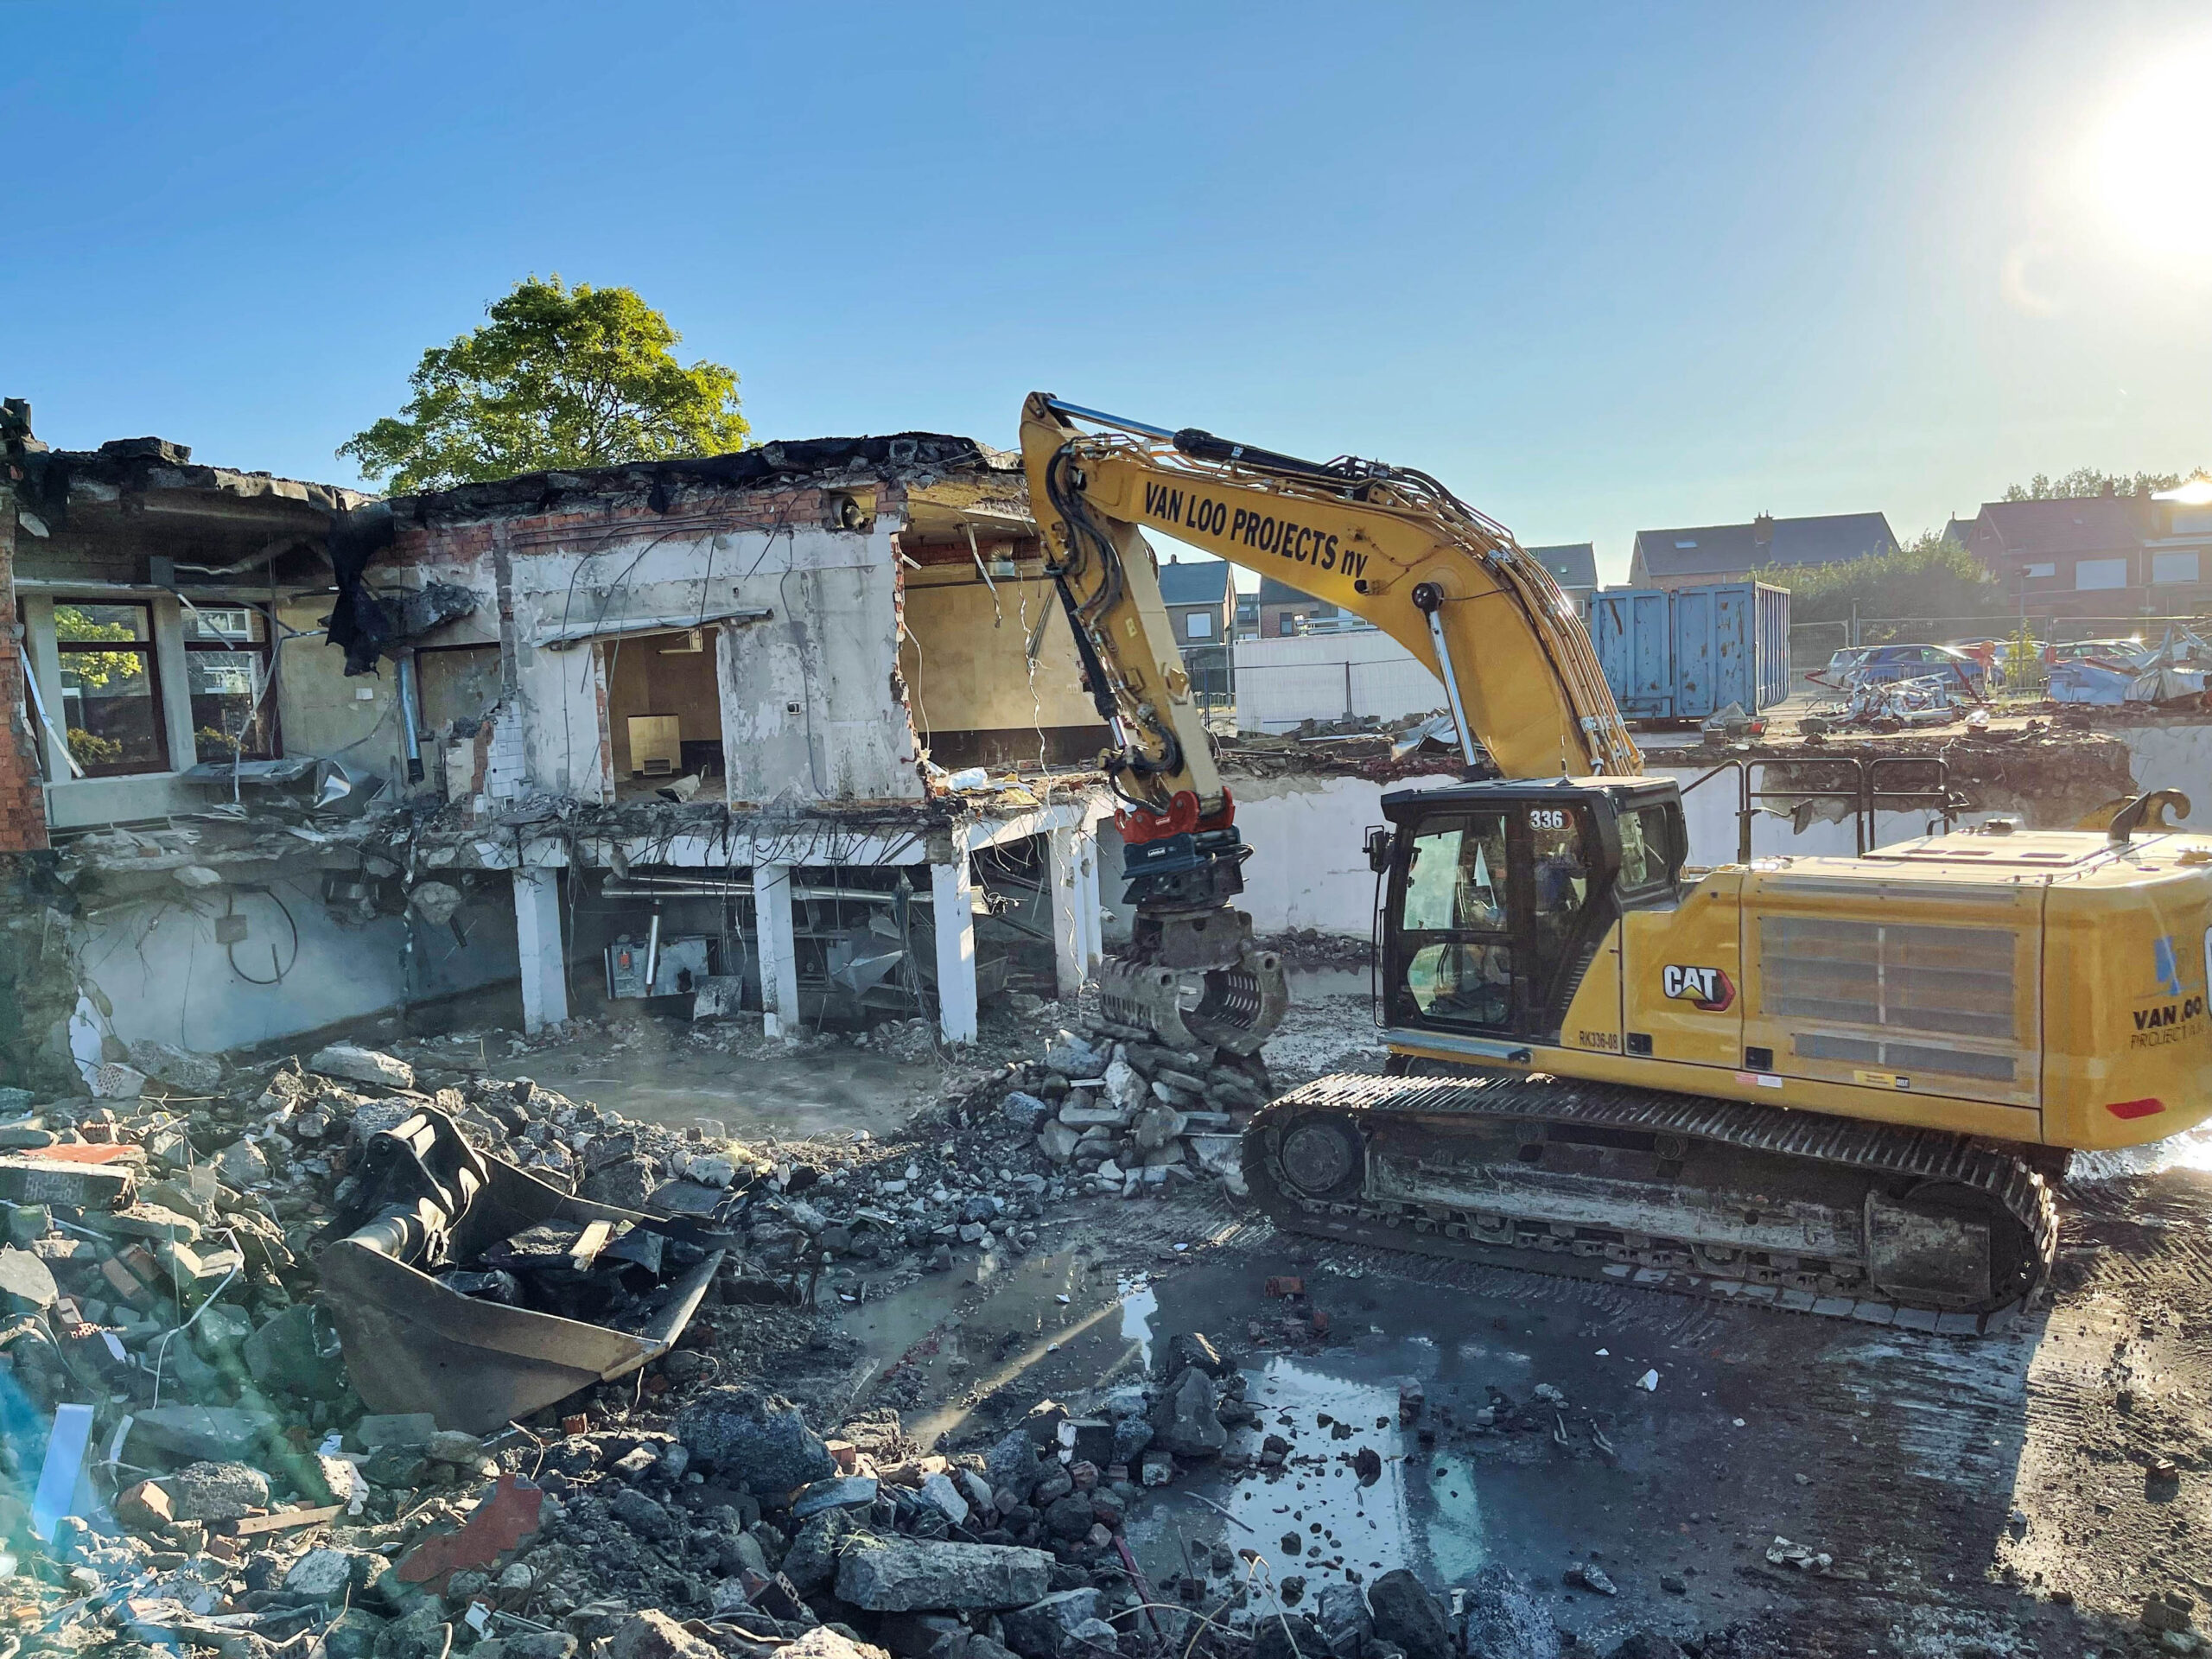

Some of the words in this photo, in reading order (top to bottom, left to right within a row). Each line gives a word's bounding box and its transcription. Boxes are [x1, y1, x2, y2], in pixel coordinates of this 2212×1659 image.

[1145, 481, 1185, 523] VAN
[1185, 494, 1227, 537] LOO
[1230, 507, 1338, 570] PROJECTS
[1529, 810, 1563, 830] 336
[1663, 964, 1717, 1001] CAT
[2133, 1005, 2177, 1031] VAN
